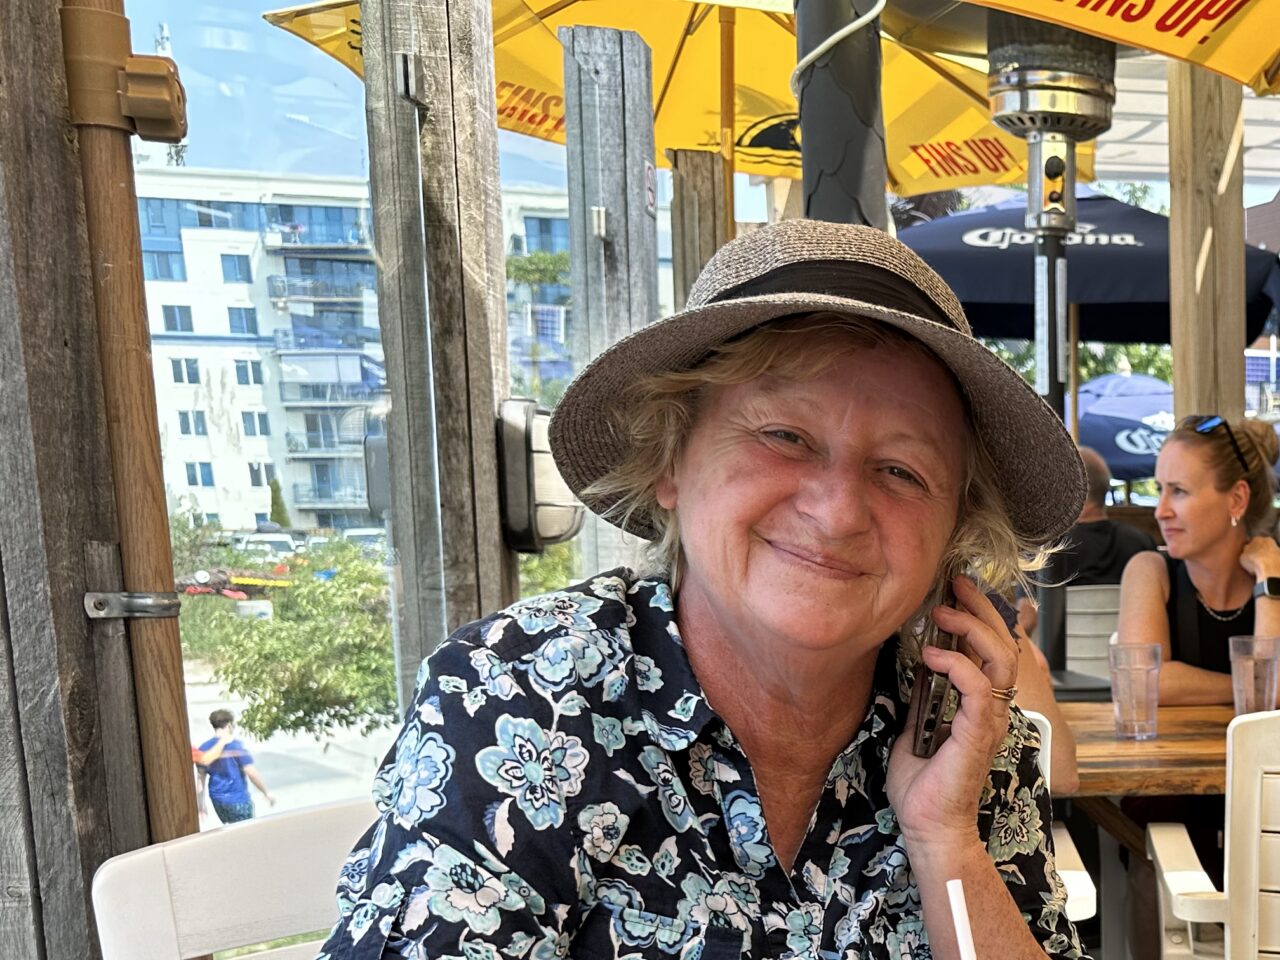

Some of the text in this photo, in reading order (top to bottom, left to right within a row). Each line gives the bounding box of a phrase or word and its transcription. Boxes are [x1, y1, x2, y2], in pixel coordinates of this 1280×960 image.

[1155, 0, 1250, 45] UP!
[909, 137, 1024, 178] FINS UP!
[962, 227, 1143, 249] Coona
